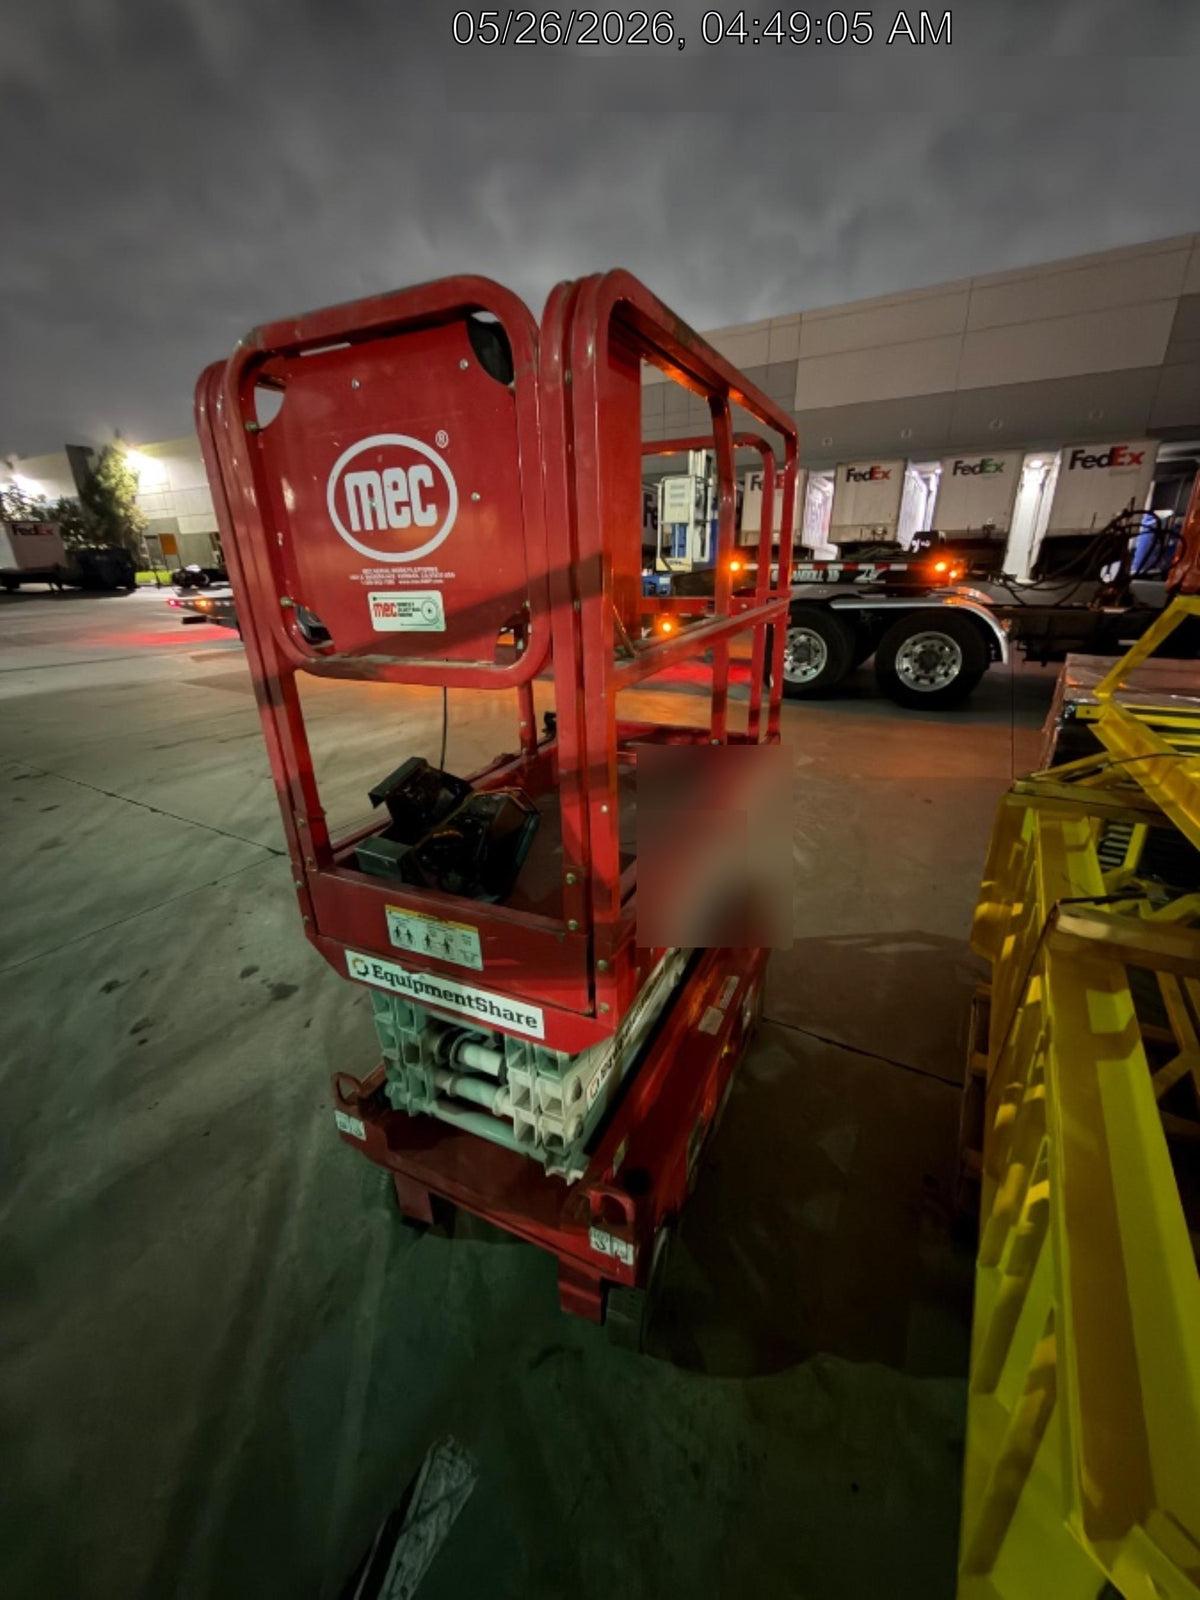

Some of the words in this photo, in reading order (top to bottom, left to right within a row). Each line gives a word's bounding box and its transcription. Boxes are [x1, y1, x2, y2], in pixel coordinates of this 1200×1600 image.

[953, 458, 1005, 477] FedEx
[1069, 446, 1146, 470] FedEx
[846, 466, 892, 483] FedEx
[11, 523, 54, 536] FedEx
[371, 964, 538, 1029] EquipmentShare
